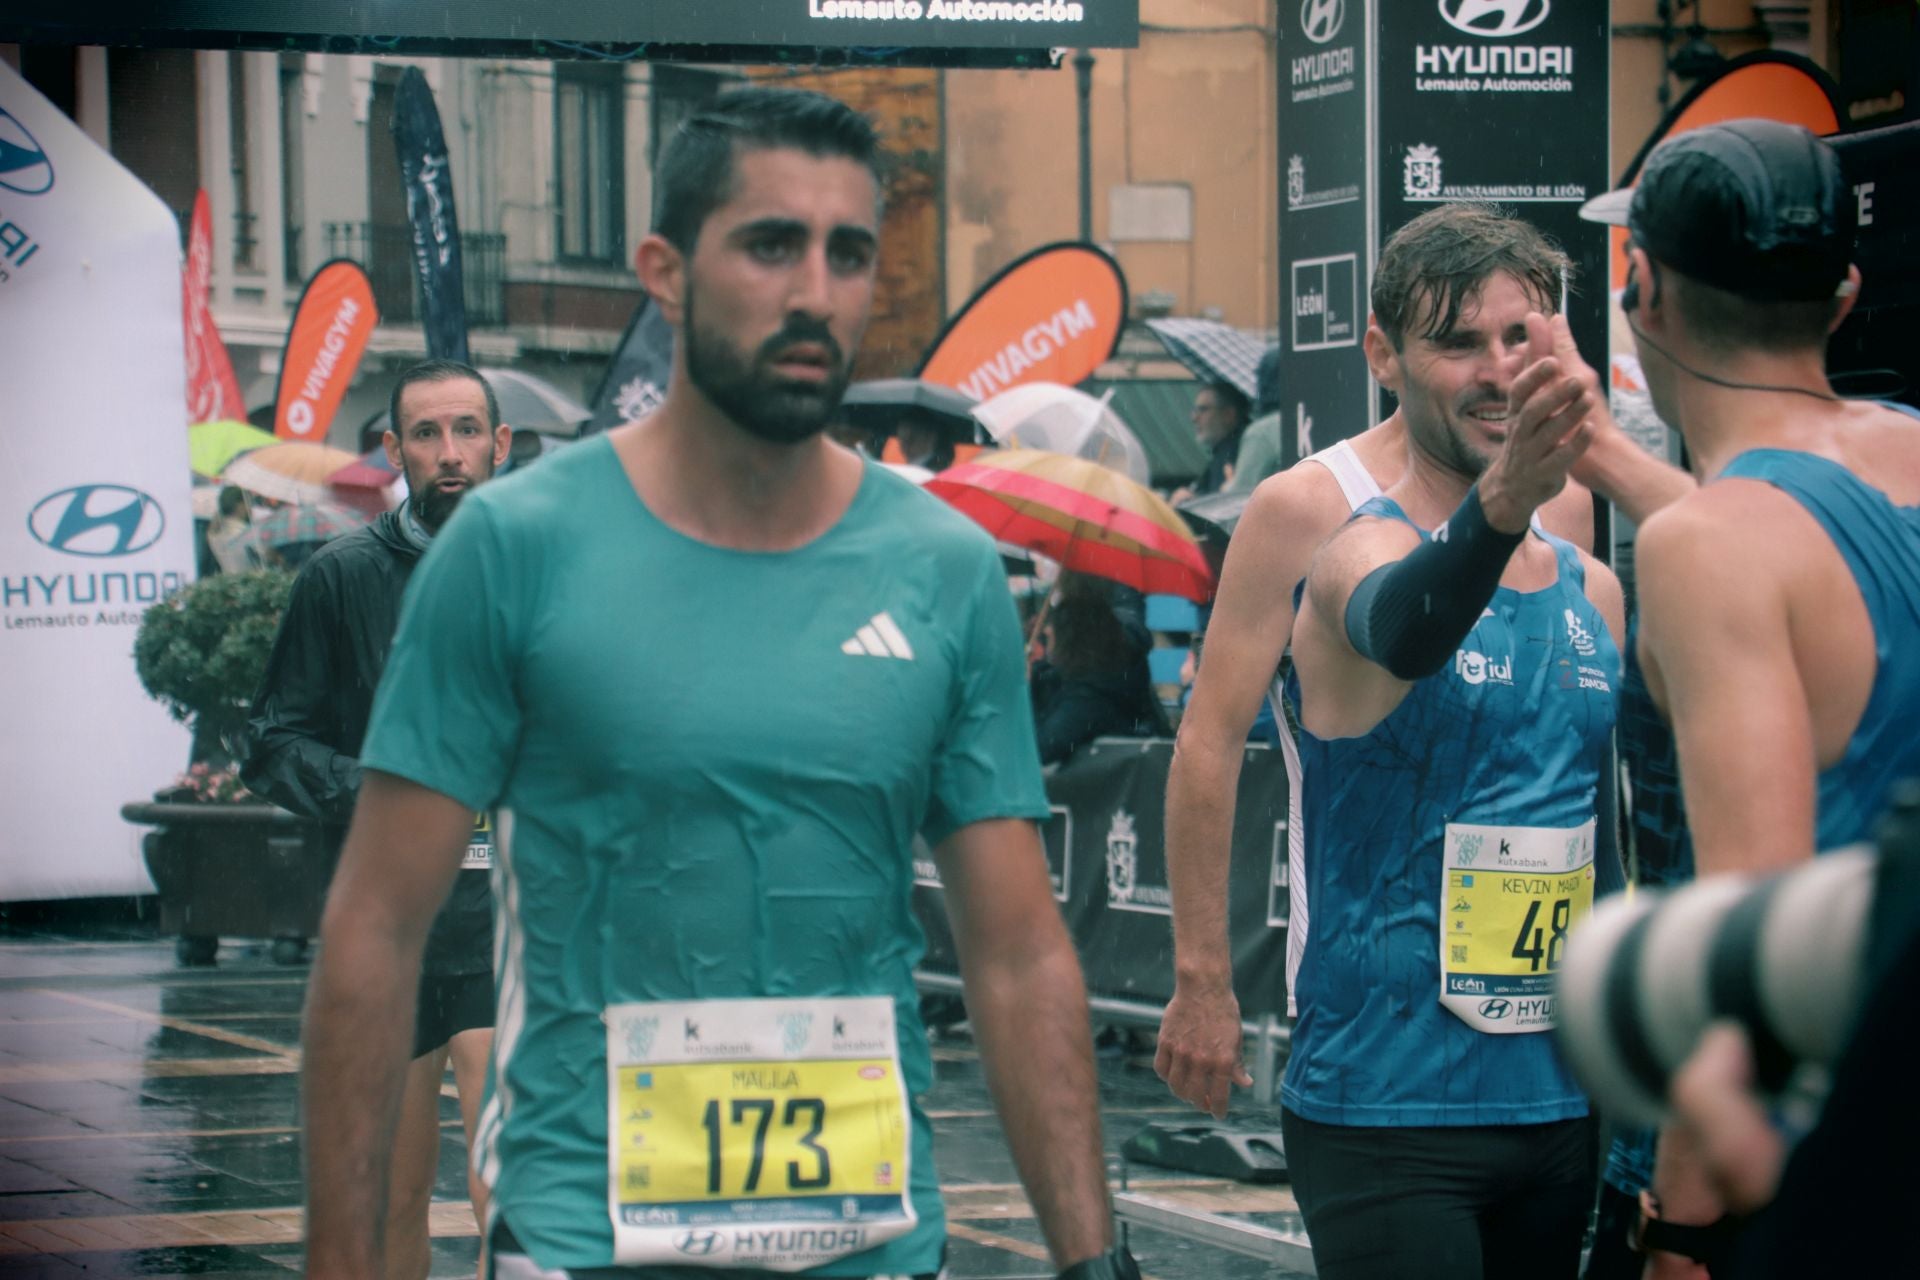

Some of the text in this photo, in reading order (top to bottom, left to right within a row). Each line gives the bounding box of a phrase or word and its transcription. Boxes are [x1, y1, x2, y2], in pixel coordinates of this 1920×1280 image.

[809, 0, 1083, 22] Lemauto Automoción
[1292, 46, 1354, 86] HYUNDAI
[1416, 45, 1573, 74] HYUNDAI
[1416, 77, 1572, 91] Lemauto Automoción
[1443, 183, 1586, 197] AYUNTAMIENTO DE LEÓN
[1296, 287, 1323, 317] LEÓN
[302, 297, 362, 402] VIVAGYM
[957, 298, 1097, 401] VIVAGYM
[1297, 401, 1313, 459] k
[5, 613, 89, 630] Lemauto
[1500, 838, 1511, 856] k
[1498, 857, 1549, 868] kutxabank
[1502, 878, 1551, 894] KEVIN
[1512, 898, 1571, 972] 48
[684, 1018, 700, 1041] k
[702, 1097, 831, 1194] 173
[734, 1229, 868, 1251] HYUNDAI
